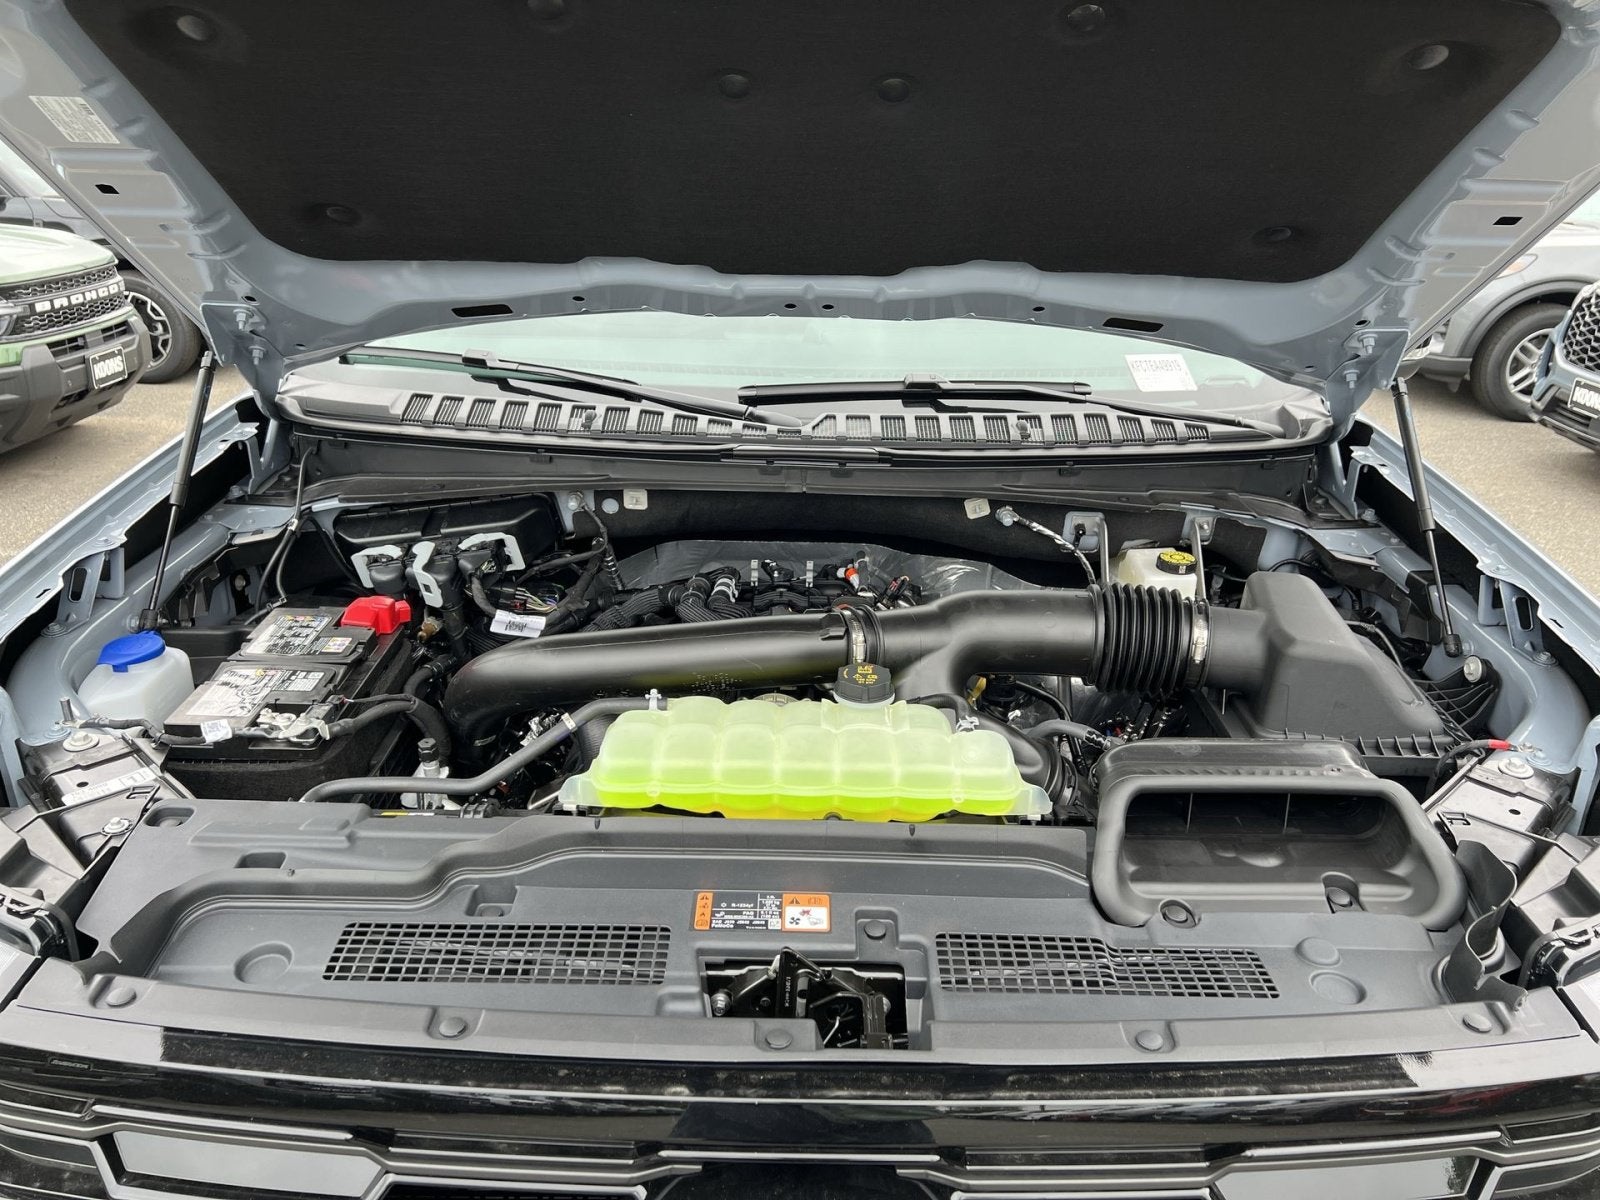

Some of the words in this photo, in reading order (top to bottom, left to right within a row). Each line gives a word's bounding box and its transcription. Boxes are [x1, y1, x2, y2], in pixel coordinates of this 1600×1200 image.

[35, 283, 119, 313] BRONCO
[93, 356, 124, 380] KOONS
[1572, 386, 1600, 411] KOON
